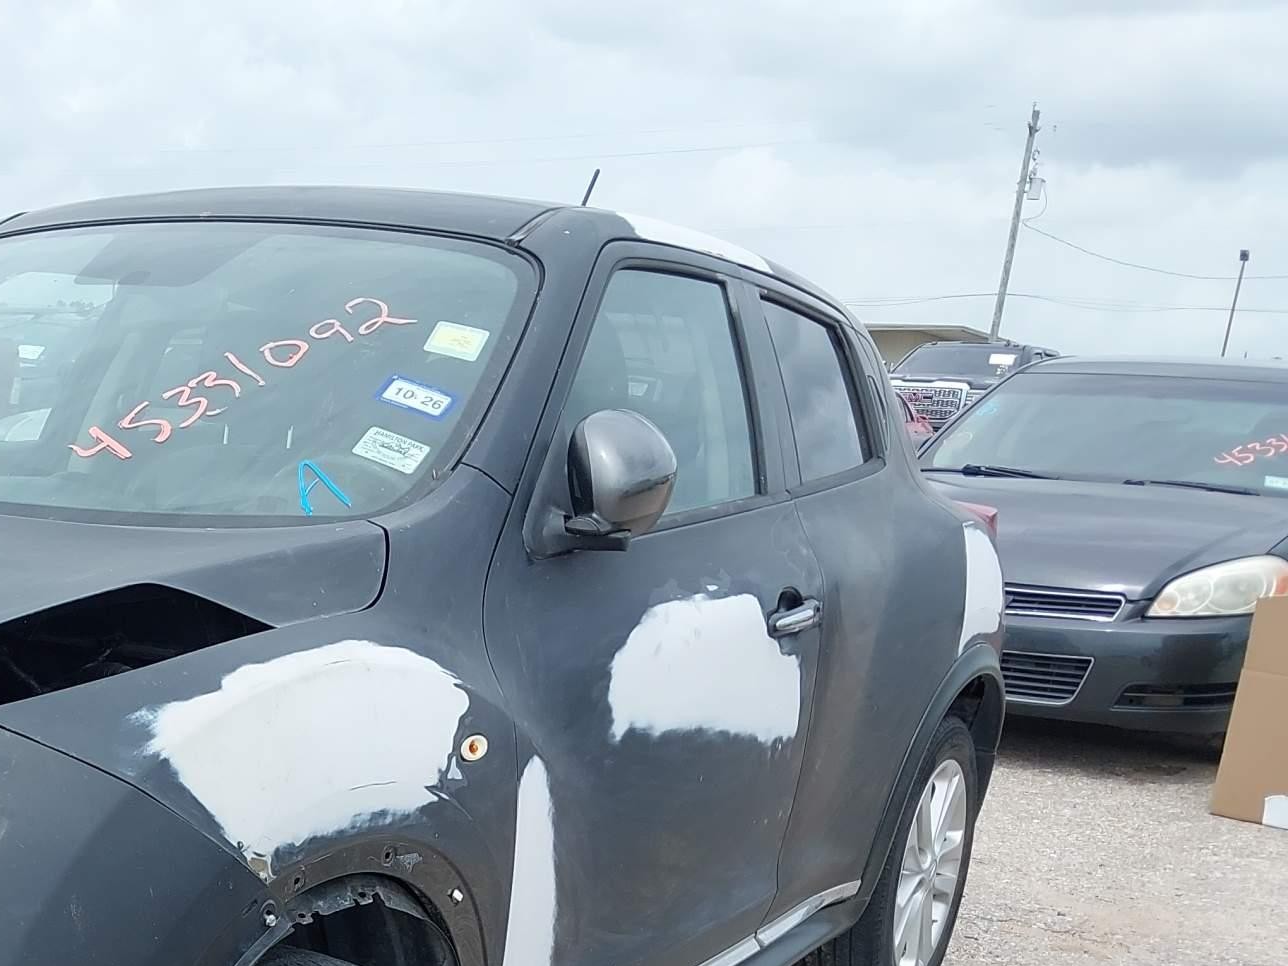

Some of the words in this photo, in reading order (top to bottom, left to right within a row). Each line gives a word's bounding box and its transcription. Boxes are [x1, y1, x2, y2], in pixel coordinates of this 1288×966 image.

[66, 297, 418, 460] 45331092
[420, 395, 445, 411] 26
[297, 459, 352, 517] A
